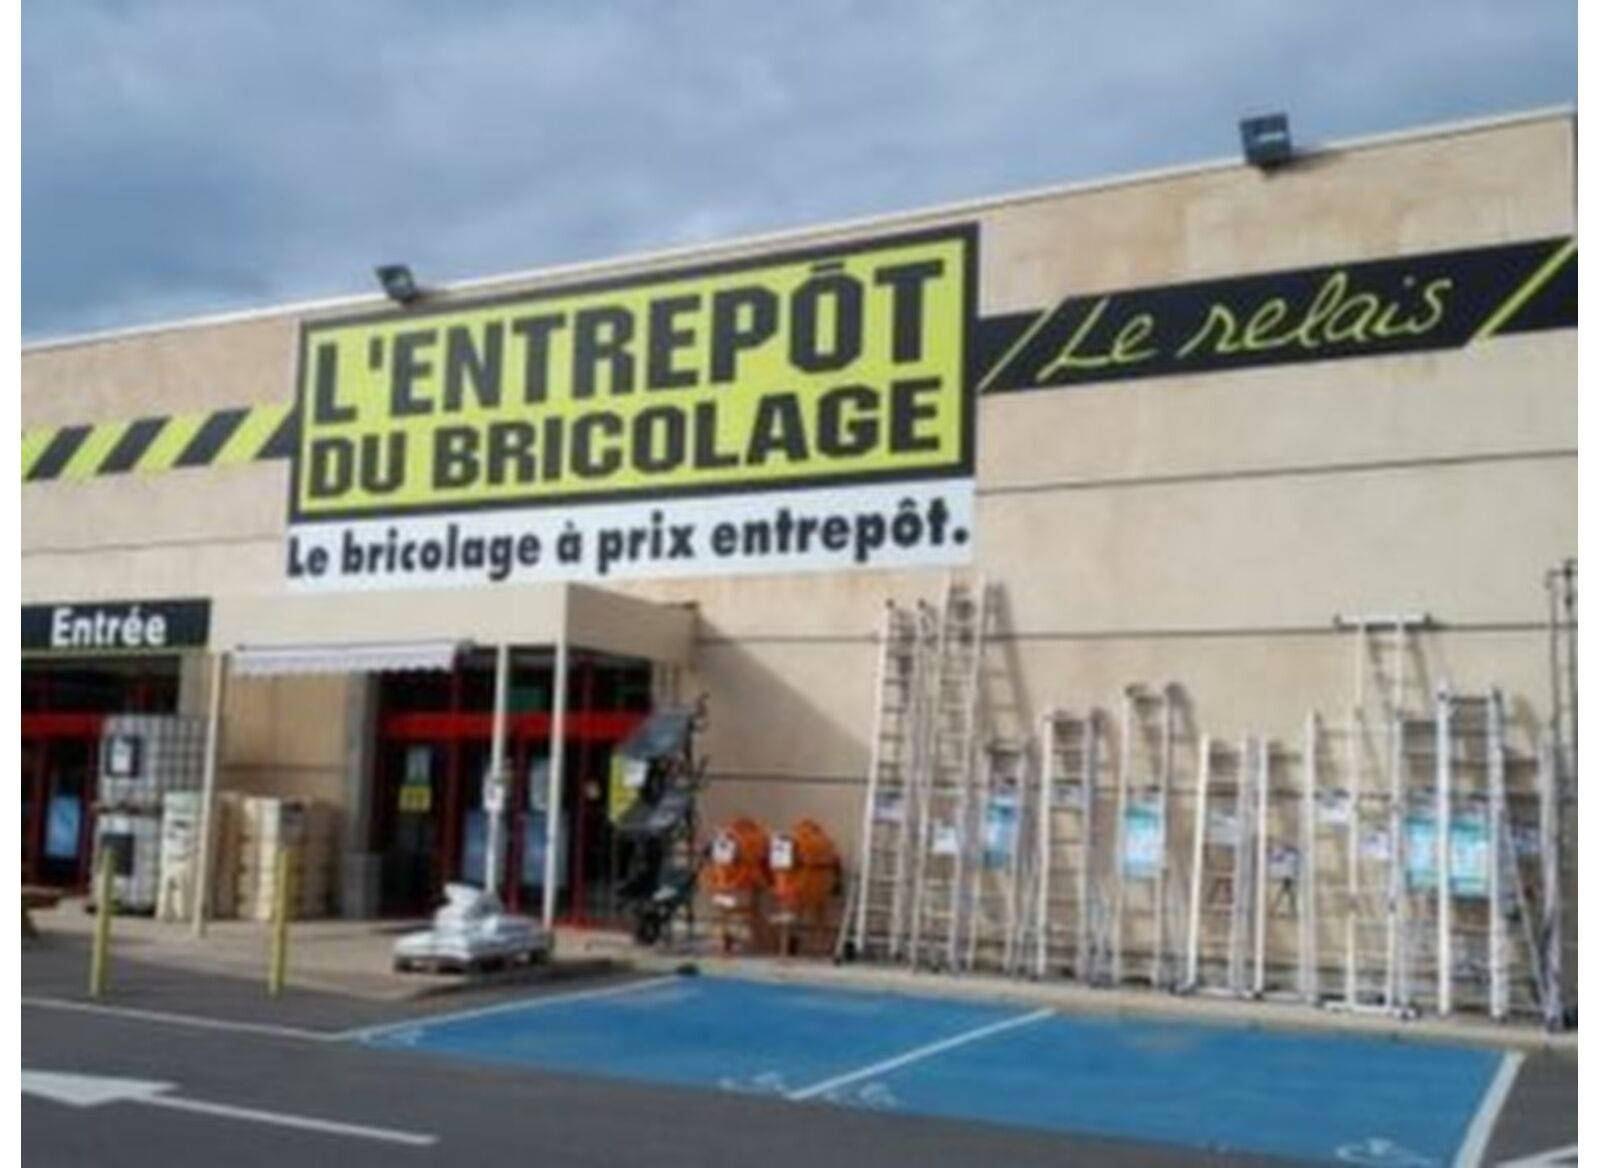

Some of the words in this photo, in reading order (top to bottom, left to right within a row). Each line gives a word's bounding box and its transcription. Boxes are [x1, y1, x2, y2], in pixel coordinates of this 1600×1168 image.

[313, 259, 946, 425] L'ENTREPÔT
[1035, 297, 1158, 382] Le
[1176, 271, 1455, 358] relais
[308, 433, 403, 499] DU
[432, 377, 943, 490] BRICOLAGE
[286, 537, 329, 577] Le
[341, 526, 542, 580] bricolage
[556, 519, 582, 564] à
[597, 510, 695, 573] prix
[712, 497, 970, 564] entrepôt.
[52, 605, 168, 648] Entrée
